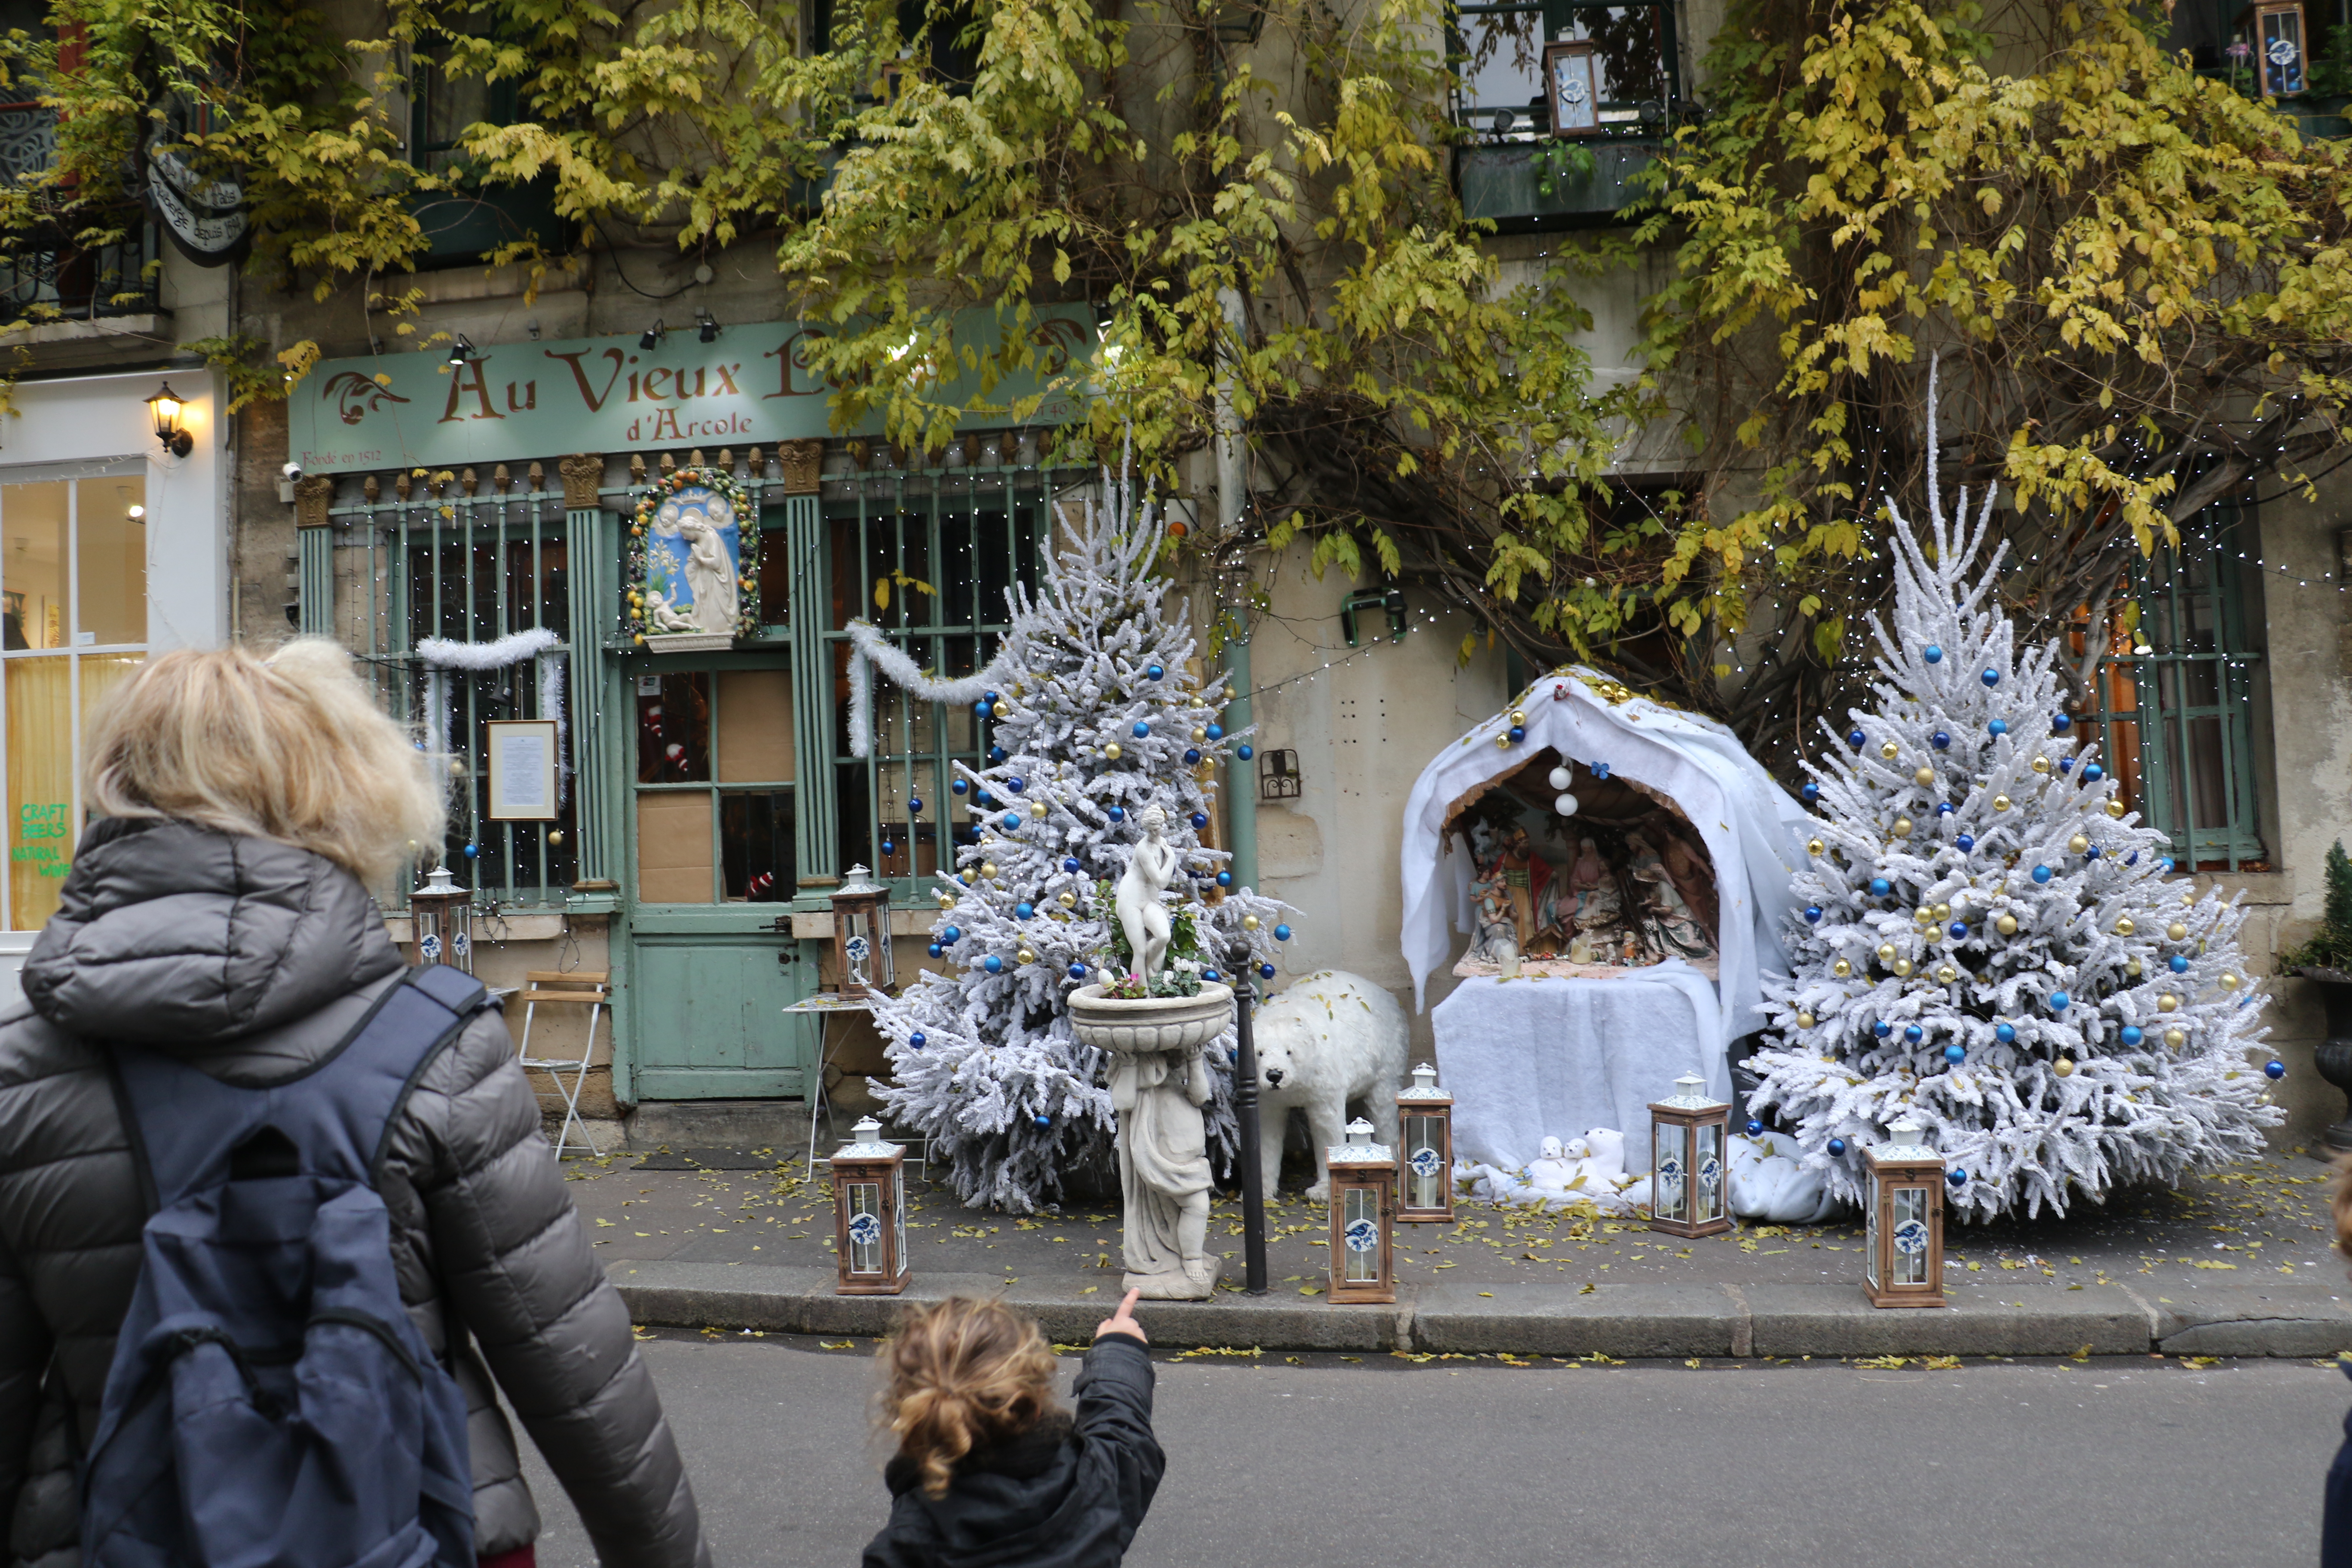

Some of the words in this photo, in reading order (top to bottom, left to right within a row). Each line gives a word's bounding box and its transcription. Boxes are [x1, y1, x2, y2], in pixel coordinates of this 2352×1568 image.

[193, 224, 223, 246] depuis
[437, 355, 536, 424] Au
[544, 346, 741, 413] Vieux
[1050, 402, 1068, 418] 40
[627, 407, 752, 442] d'Arcole
[301, 450, 337, 470] Fondé
[342, 453, 355, 469] en
[359, 450, 381, 466] 1512
[21, 803, 67, 821] CRAFT
[21, 822, 67, 839] BEERS
